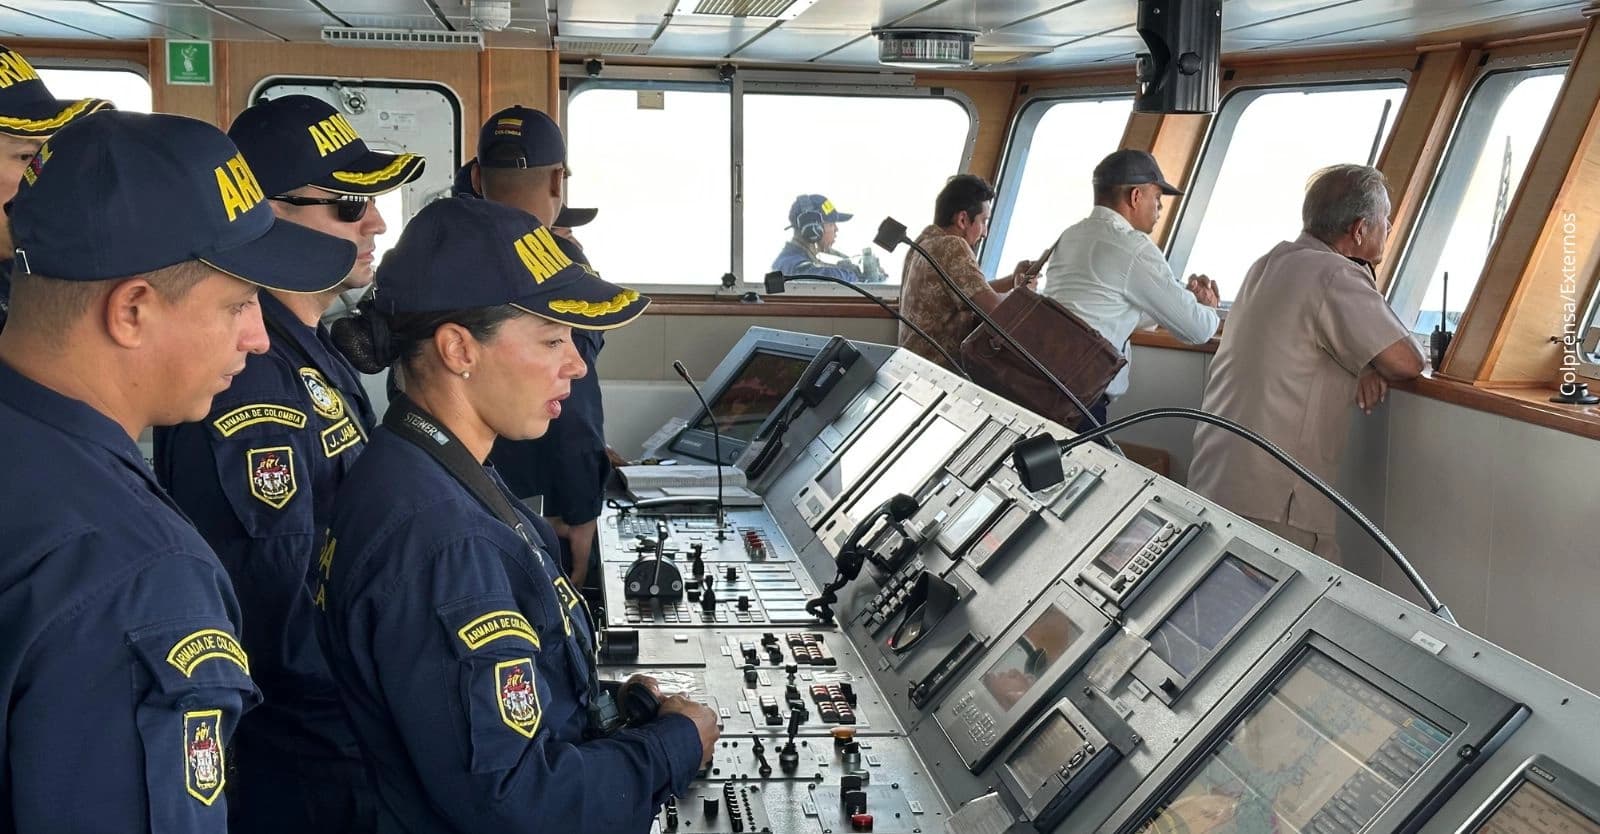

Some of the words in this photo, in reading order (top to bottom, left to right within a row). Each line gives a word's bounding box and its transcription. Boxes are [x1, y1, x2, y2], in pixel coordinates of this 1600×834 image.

[222, 411, 251, 430] ARMADA
[252, 409, 262, 417] DE
[264, 409, 300, 424] COLOMBIA
[330, 434, 340, 448] J.
[467, 620, 500, 643] ARMADA
[500, 618, 511, 628] DE
[176, 639, 206, 668] ARMADA
[203, 636, 216, 650] DE
